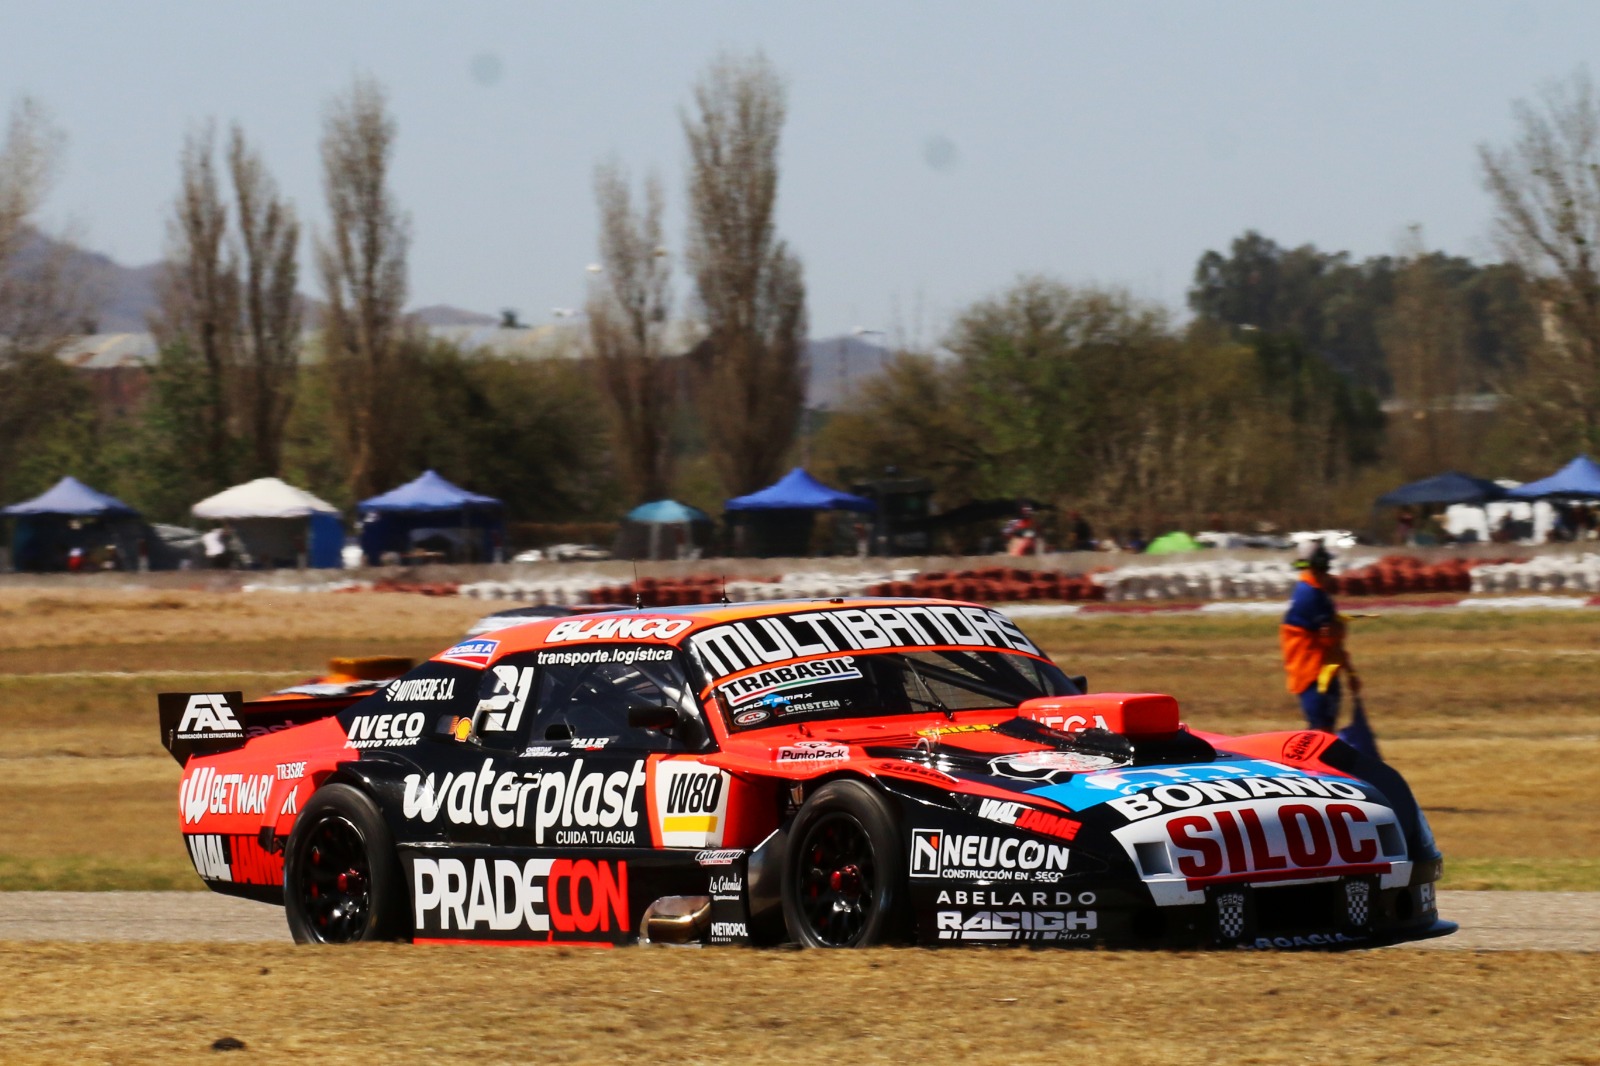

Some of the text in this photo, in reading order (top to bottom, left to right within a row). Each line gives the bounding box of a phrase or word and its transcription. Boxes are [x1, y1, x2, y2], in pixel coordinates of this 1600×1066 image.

[545, 618, 693, 643] BLANCO
[690, 605, 1041, 678] MULTIBANDAS
[393, 678, 454, 702] AUTOSEDE S.A.
[722, 658, 856, 697] TRABASIL
[177, 694, 243, 732] FAE
[477, 665, 534, 732] 21
[785, 700, 841, 713] CRISTEM
[348, 712, 425, 740] IVECO
[344, 737, 420, 749] PUNTO TRUCK
[403, 758, 646, 844] waterplast
[667, 771, 722, 814] W80
[1106, 777, 1366, 821] BONANO
[556, 831, 635, 844] CUIDA TU AGUA
[943, 835, 1070, 870] NEUCON
[1166, 804, 1377, 877] SILOC
[942, 868, 1012, 880] CONSTRUCCIÓN
[1014, 872, 1028, 880] EN
[414, 859, 629, 932] PRADECON
[936, 891, 1097, 905] ABELARDO
[711, 923, 748, 936] METROPOL
[937, 911, 1098, 930] RACIGH
